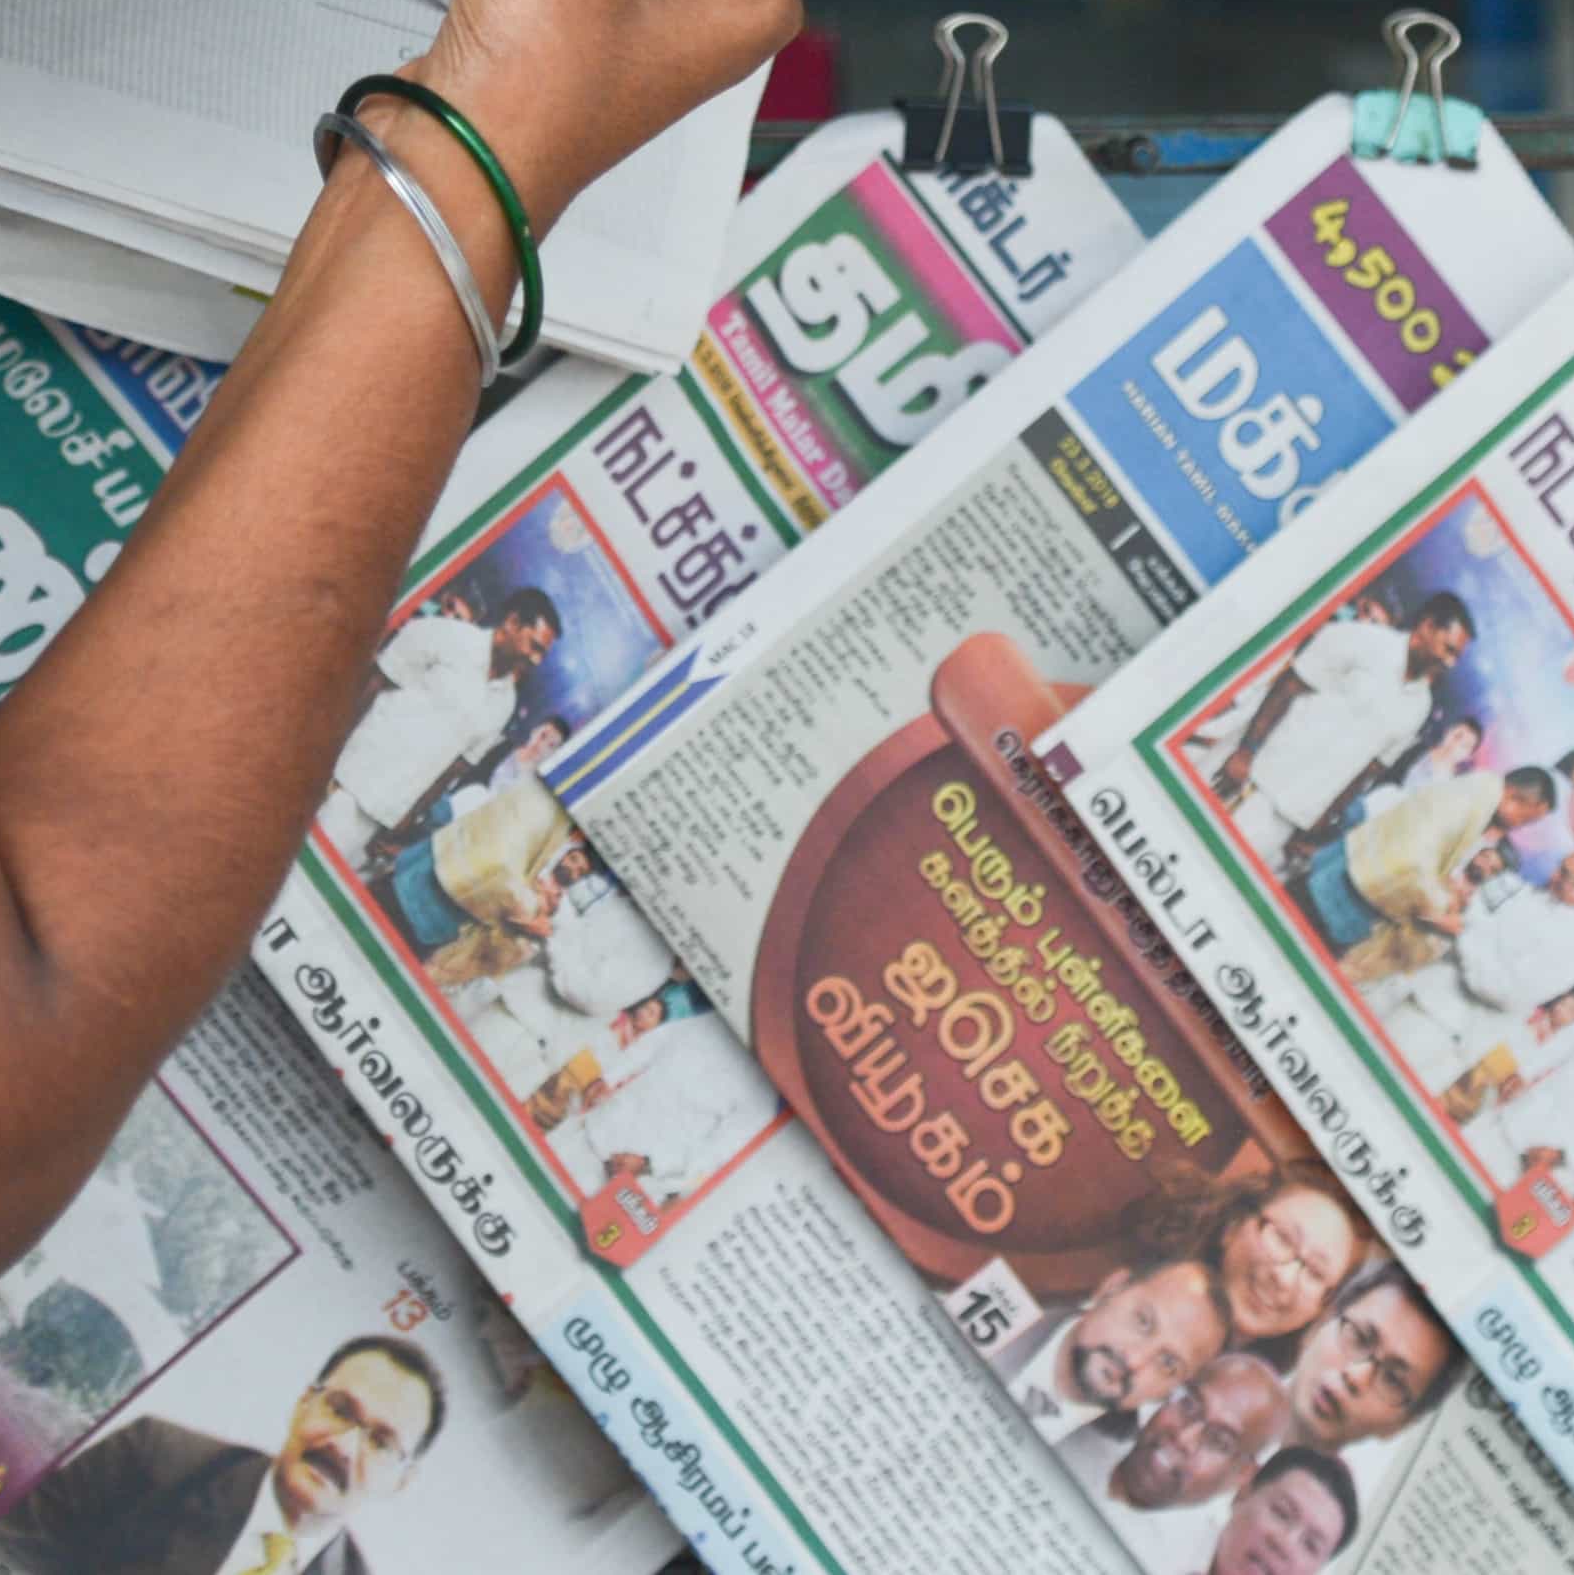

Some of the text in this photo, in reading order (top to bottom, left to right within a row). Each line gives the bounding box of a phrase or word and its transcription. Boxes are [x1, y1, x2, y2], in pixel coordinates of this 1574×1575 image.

[1311, 200, 1440, 353] 4,500
[707, 311, 788, 392] Tamil
[766, 387, 839, 463] Malar
[884, 942, 1069, 1165] ஜசெக
[920, 852, 1153, 1159] களத்தில் நிறுத்த
[932, 782, 1210, 1146] பெரும் புள்ளிகளை
[1090, 788, 1426, 1249] பெல்டா ஆர்வலருக்கு
[293, 963, 513, 1258] ஆர்வலருக்கு
[806, 976, 1022, 1232] வியூகம்
[375, 1281, 433, 1331] 13
[562, 1316, 632, 1395] முழு
[945, 1290, 1010, 1346] 15
[1476, 1307, 1542, 1382] முழு
